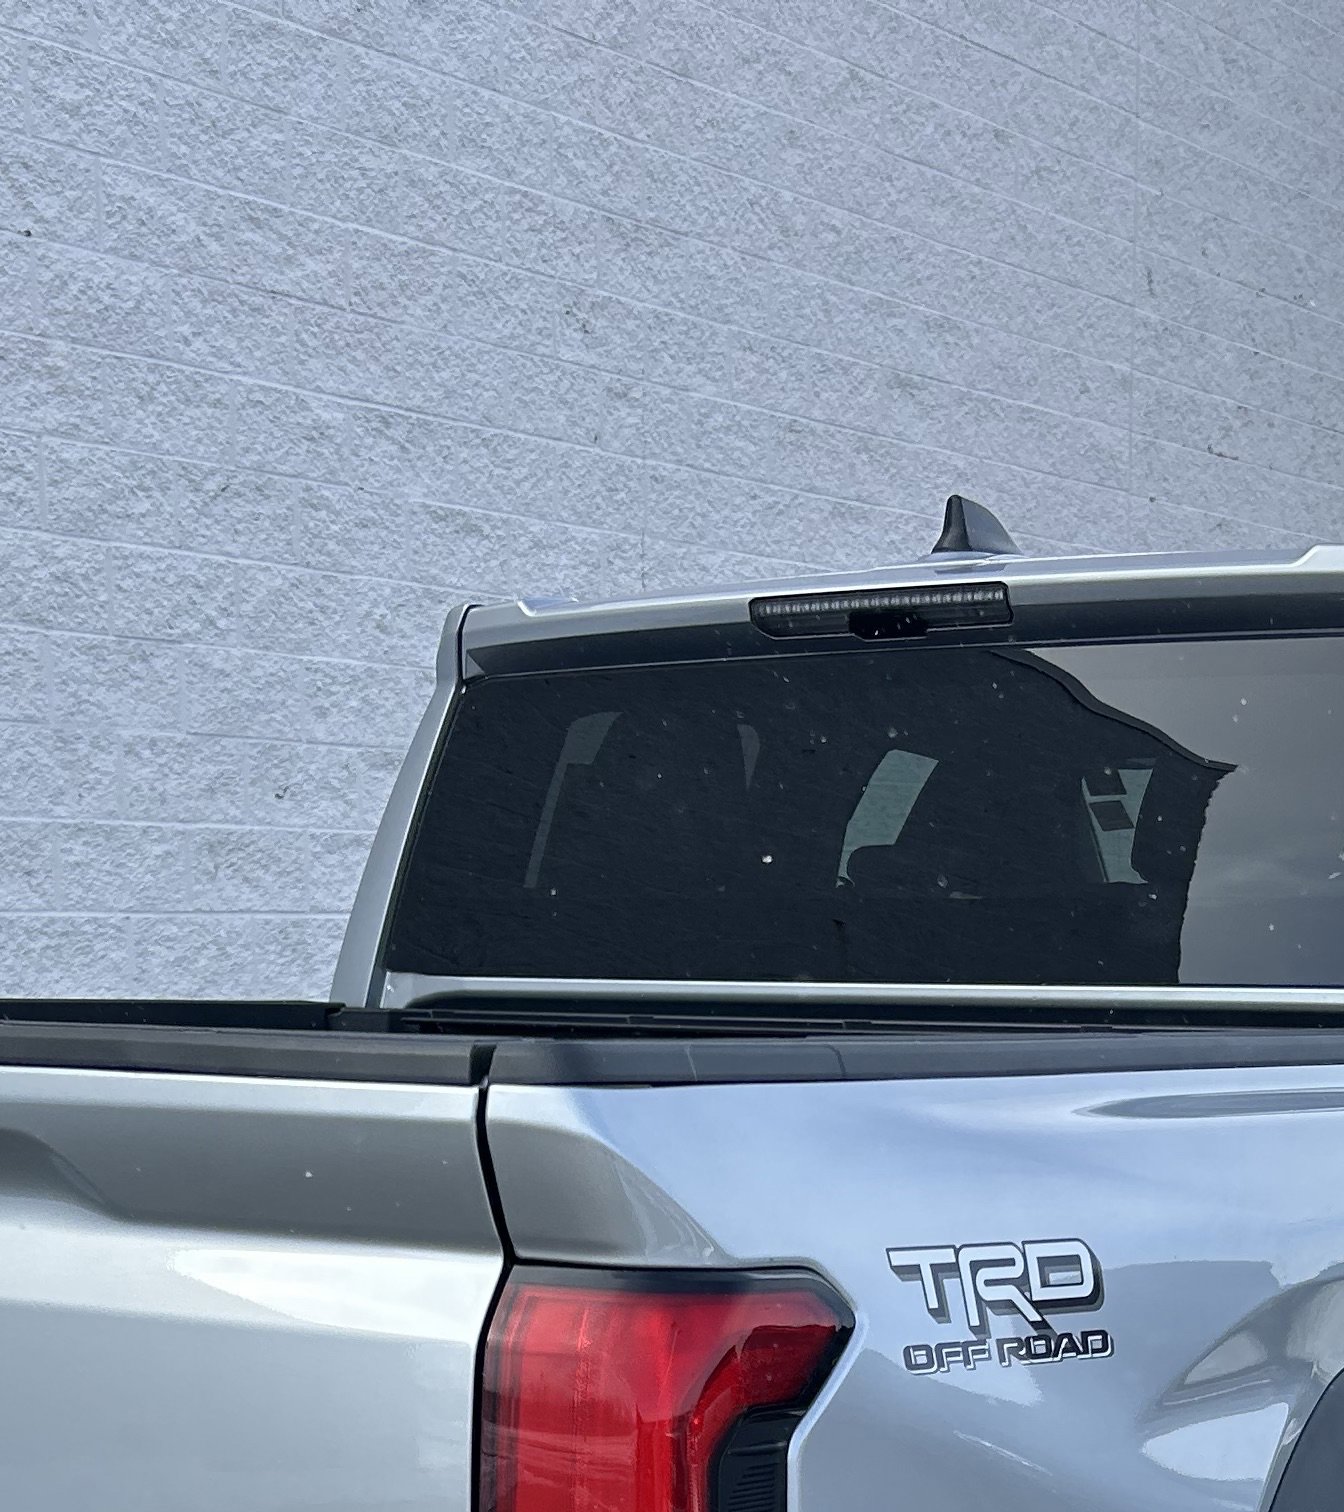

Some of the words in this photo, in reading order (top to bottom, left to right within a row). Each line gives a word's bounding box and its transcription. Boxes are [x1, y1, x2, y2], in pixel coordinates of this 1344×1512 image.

[885, 1237, 1105, 1340] TRD
[902, 1338, 992, 1376] OFF
[995, 1329, 1115, 1368] ROAD
